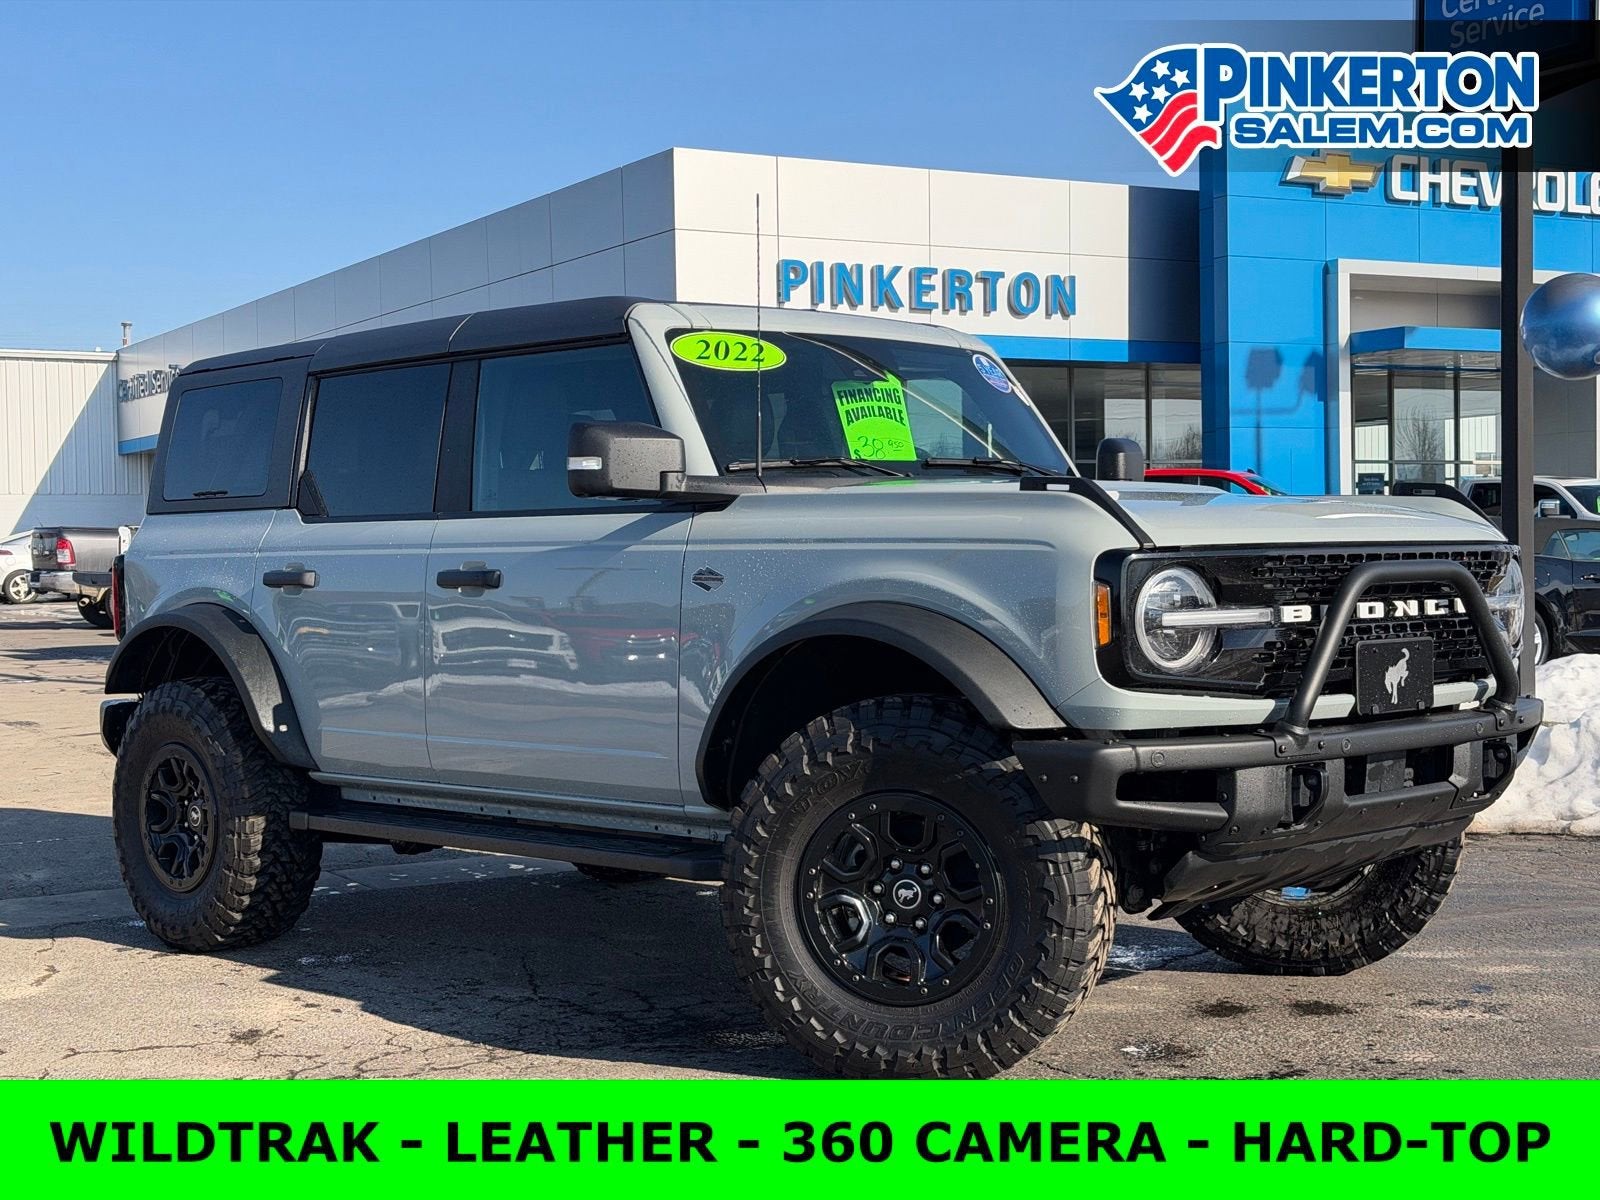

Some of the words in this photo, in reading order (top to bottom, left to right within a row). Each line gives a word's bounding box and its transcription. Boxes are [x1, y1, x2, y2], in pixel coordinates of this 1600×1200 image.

[1450, 3, 1545, 48] Service
[1389, 154, 1600, 215] CHEVOL
[779, 258, 1077, 318] PINKERTON
[696, 339, 766, 362] 2022
[836, 388, 902, 406] FINANCING
[845, 405, 906, 426] AVAILABLE
[1280, 597, 1467, 623] BONC
